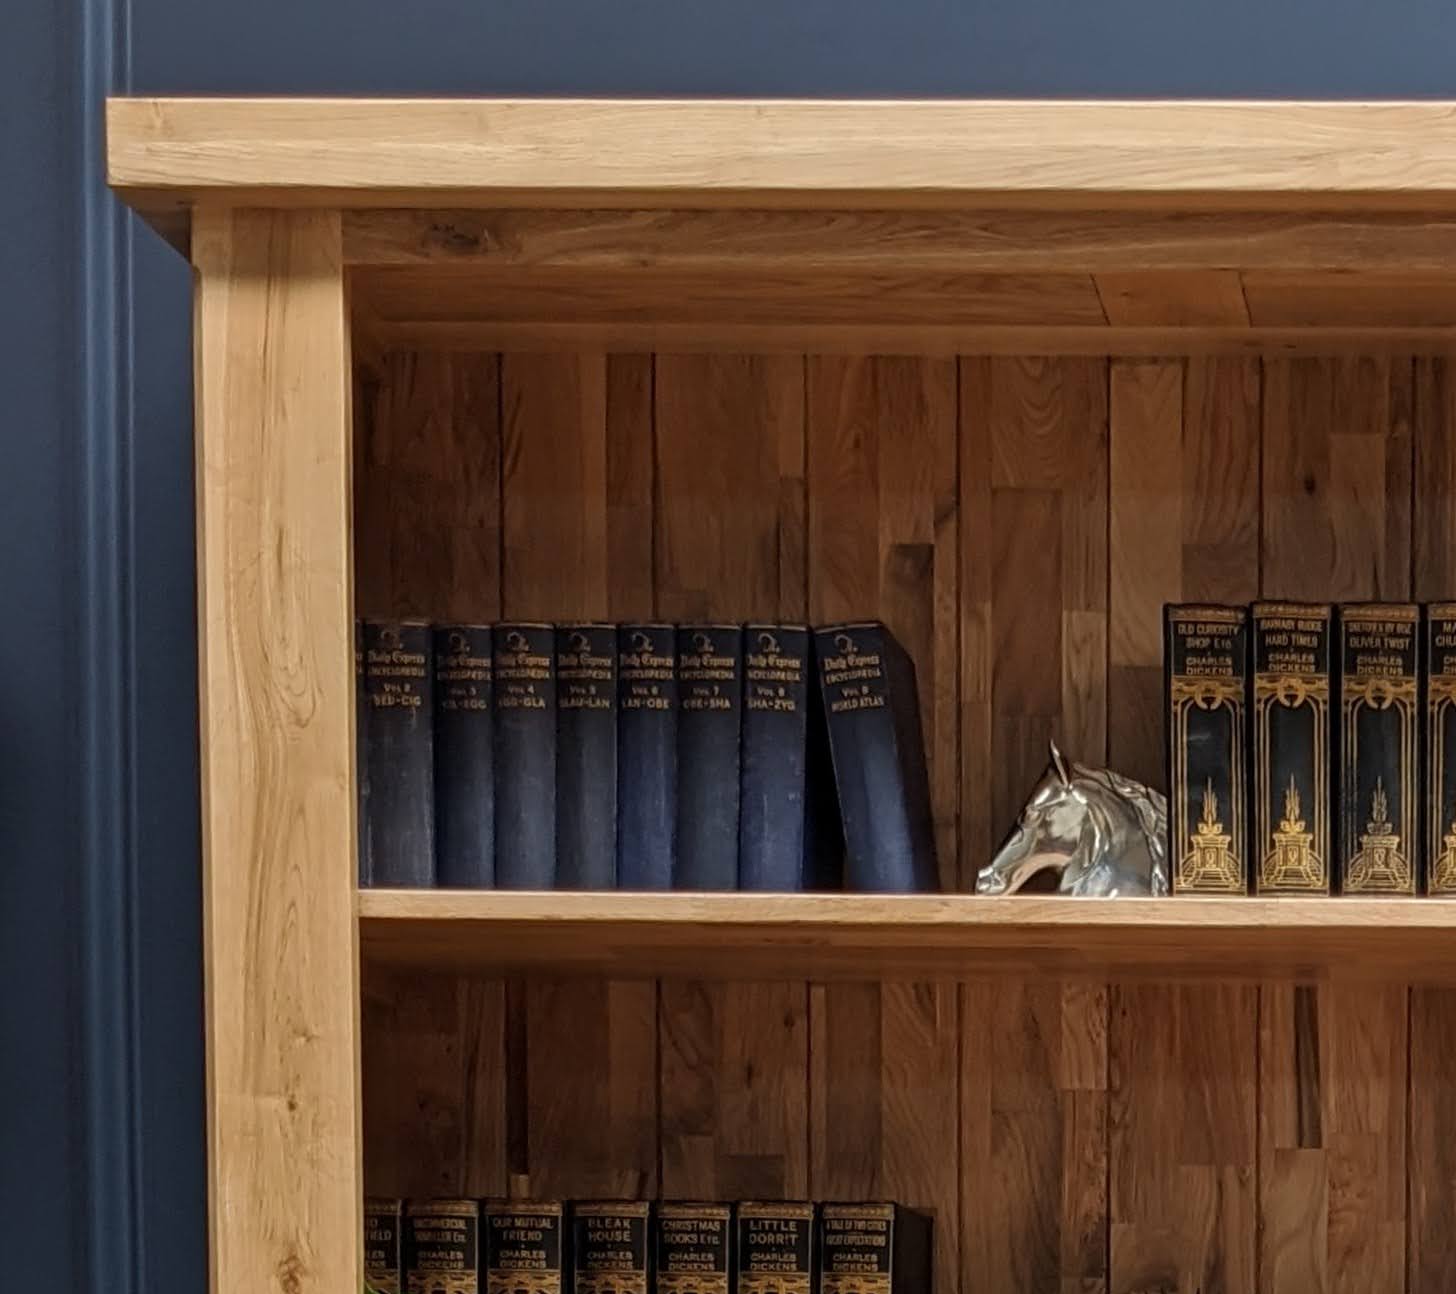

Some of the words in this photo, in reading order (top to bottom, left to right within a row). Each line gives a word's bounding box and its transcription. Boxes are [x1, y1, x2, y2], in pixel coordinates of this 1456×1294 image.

[1178, 623, 1195, 635] OLD
[1197, 623, 1240, 636] CURIOSITY
[1185, 637, 1211, 649] SHOP
[1265, 634, 1289, 647] HARD
[1291, 633, 1318, 648] TIMES
[1350, 636, 1381, 648] OLIVER
[1383, 637, 1411, 650] TWIST
[859, 696, 884, 708] ATLAS
[493, 1217, 513, 1228] OUR
[514, 1217, 554, 1229] MUTUAL
[588, 1218, 631, 1229] BLEAK
[663, 1221, 720, 1231] CHRISTMAS
[750, 1221, 797, 1231] LITTLE
[503, 1230, 543, 1241] FRIEND
[588, 1230, 632, 1242] HOUSE
[665, 1233, 698, 1244] BOOKS
[749, 1233, 799, 1245] DORRIT
[751, 1253, 797, 1262] CHARLES
[750, 1262, 798, 1272] DICKENS
